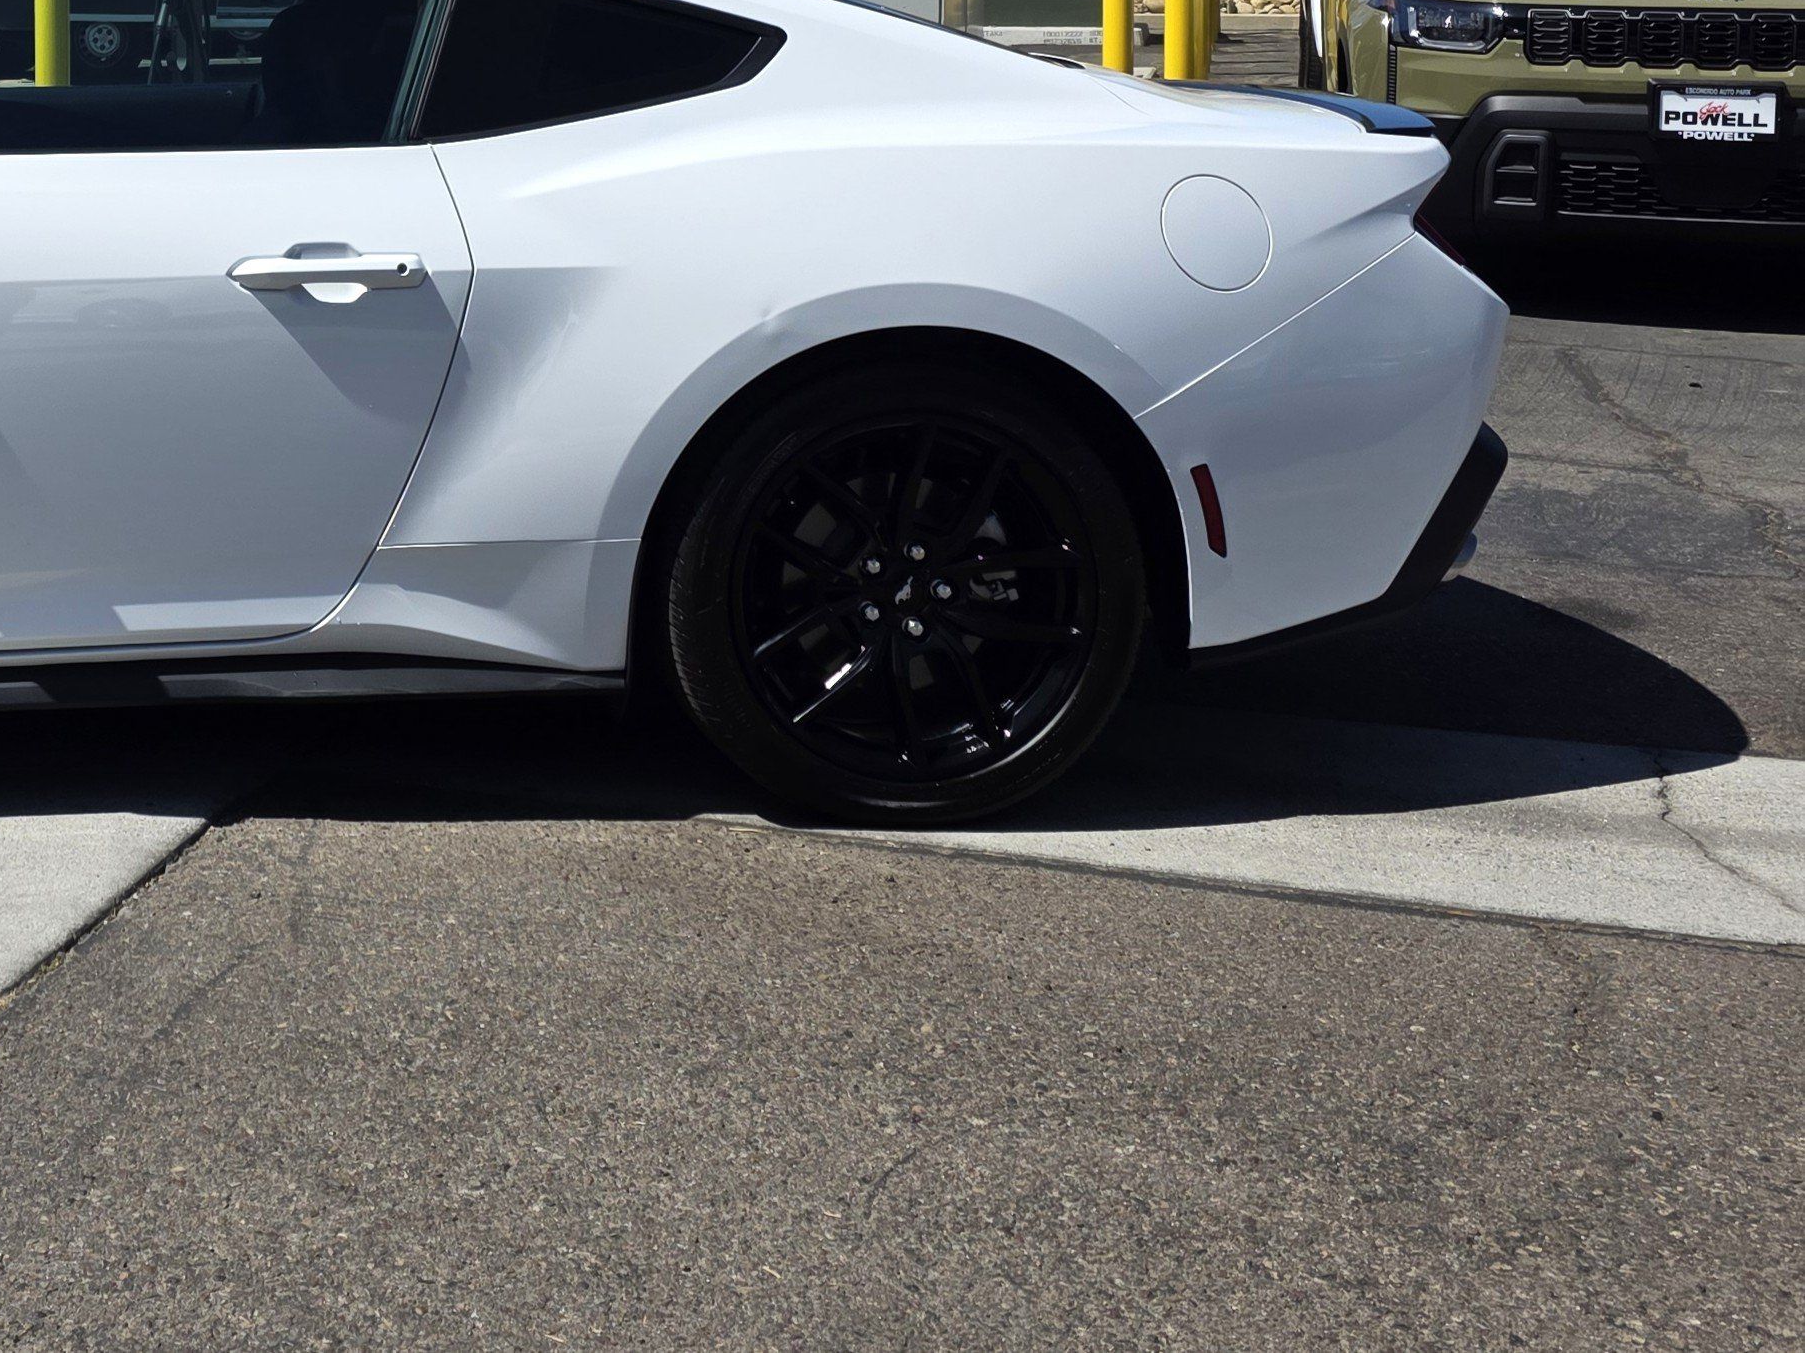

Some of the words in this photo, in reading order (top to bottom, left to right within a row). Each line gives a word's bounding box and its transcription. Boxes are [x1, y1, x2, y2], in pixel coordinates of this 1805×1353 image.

[1685, 87, 1718, 95] ESCONDIDO
[1736, 88, 1752, 96] PARK
[1699, 101, 1730, 120] Jack
[1664, 110, 1768, 128] POWELL
[1682, 130, 1753, 142] POWELL
